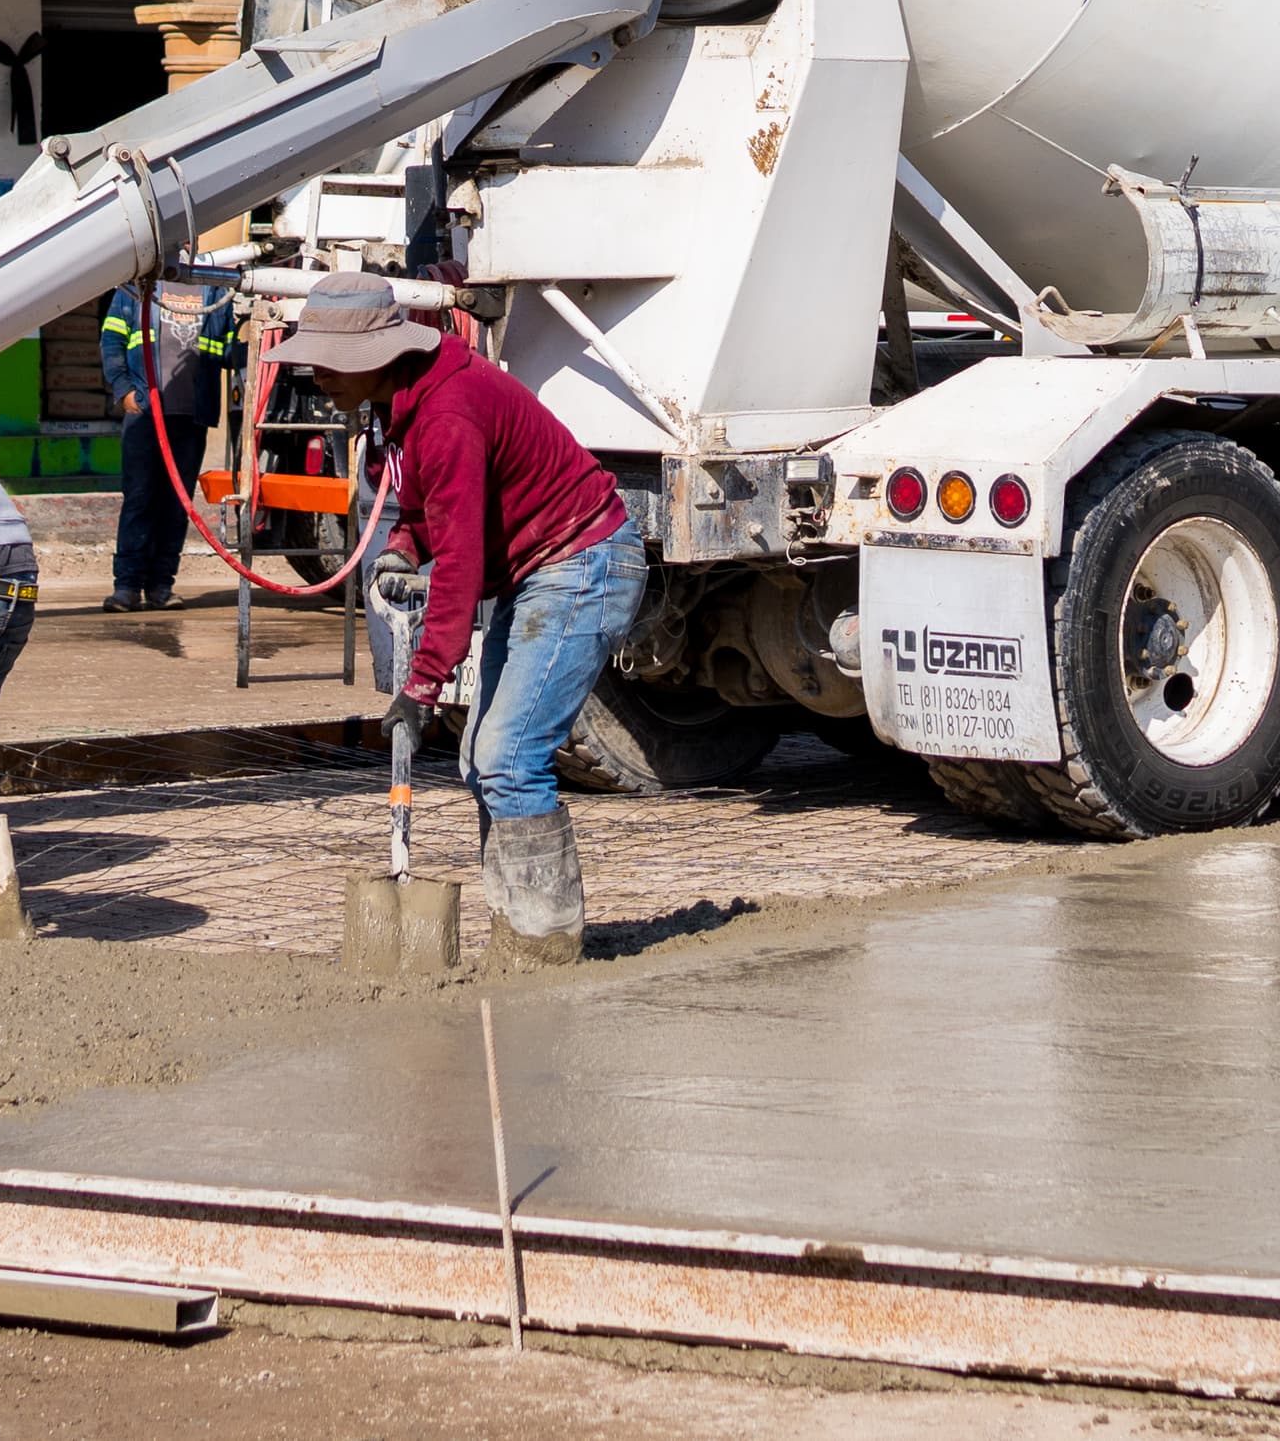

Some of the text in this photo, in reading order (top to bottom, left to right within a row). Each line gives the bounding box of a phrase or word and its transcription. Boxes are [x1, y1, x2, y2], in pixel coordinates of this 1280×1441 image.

[898, 683, 1011, 713] TEL (81) 8326-1834
[922, 713, 944, 739] (81)
[947, 715, 1015, 740] 8127-1000
